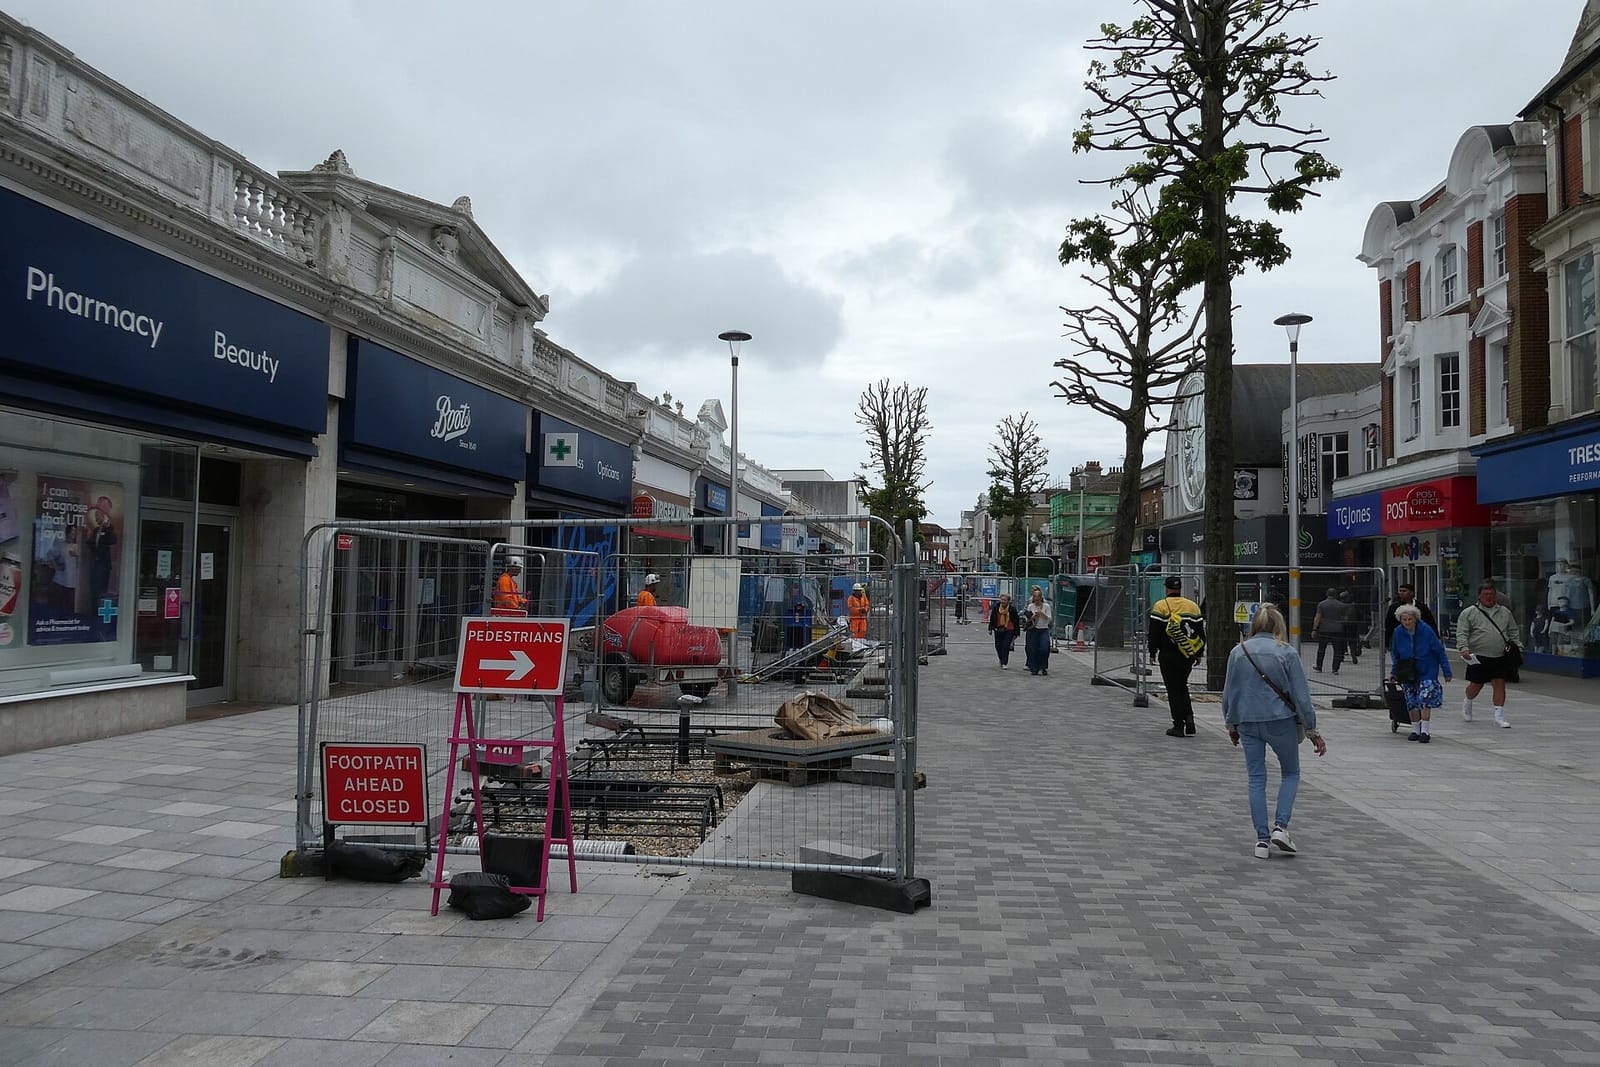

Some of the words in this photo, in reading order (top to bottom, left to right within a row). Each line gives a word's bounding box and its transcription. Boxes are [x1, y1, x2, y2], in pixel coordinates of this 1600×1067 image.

[26, 266, 164, 348] Pharmacy
[213, 330, 280, 384] Beauty
[430, 395, 471, 442] Boots
[597, 460, 620, 481] Opticians
[49, 487, 69, 497] can
[1417, 490, 1436, 499] POST
[42, 497, 88, 514] diagnose
[1386, 501, 1408, 520] POST
[42, 512, 66, 525] that
[468, 630, 563, 643] PEDESTRIANS
[329, 755, 417, 770] FOOTPATH
[344, 778, 404, 792] AHEAD
[340, 799, 410, 814] CLOSED
